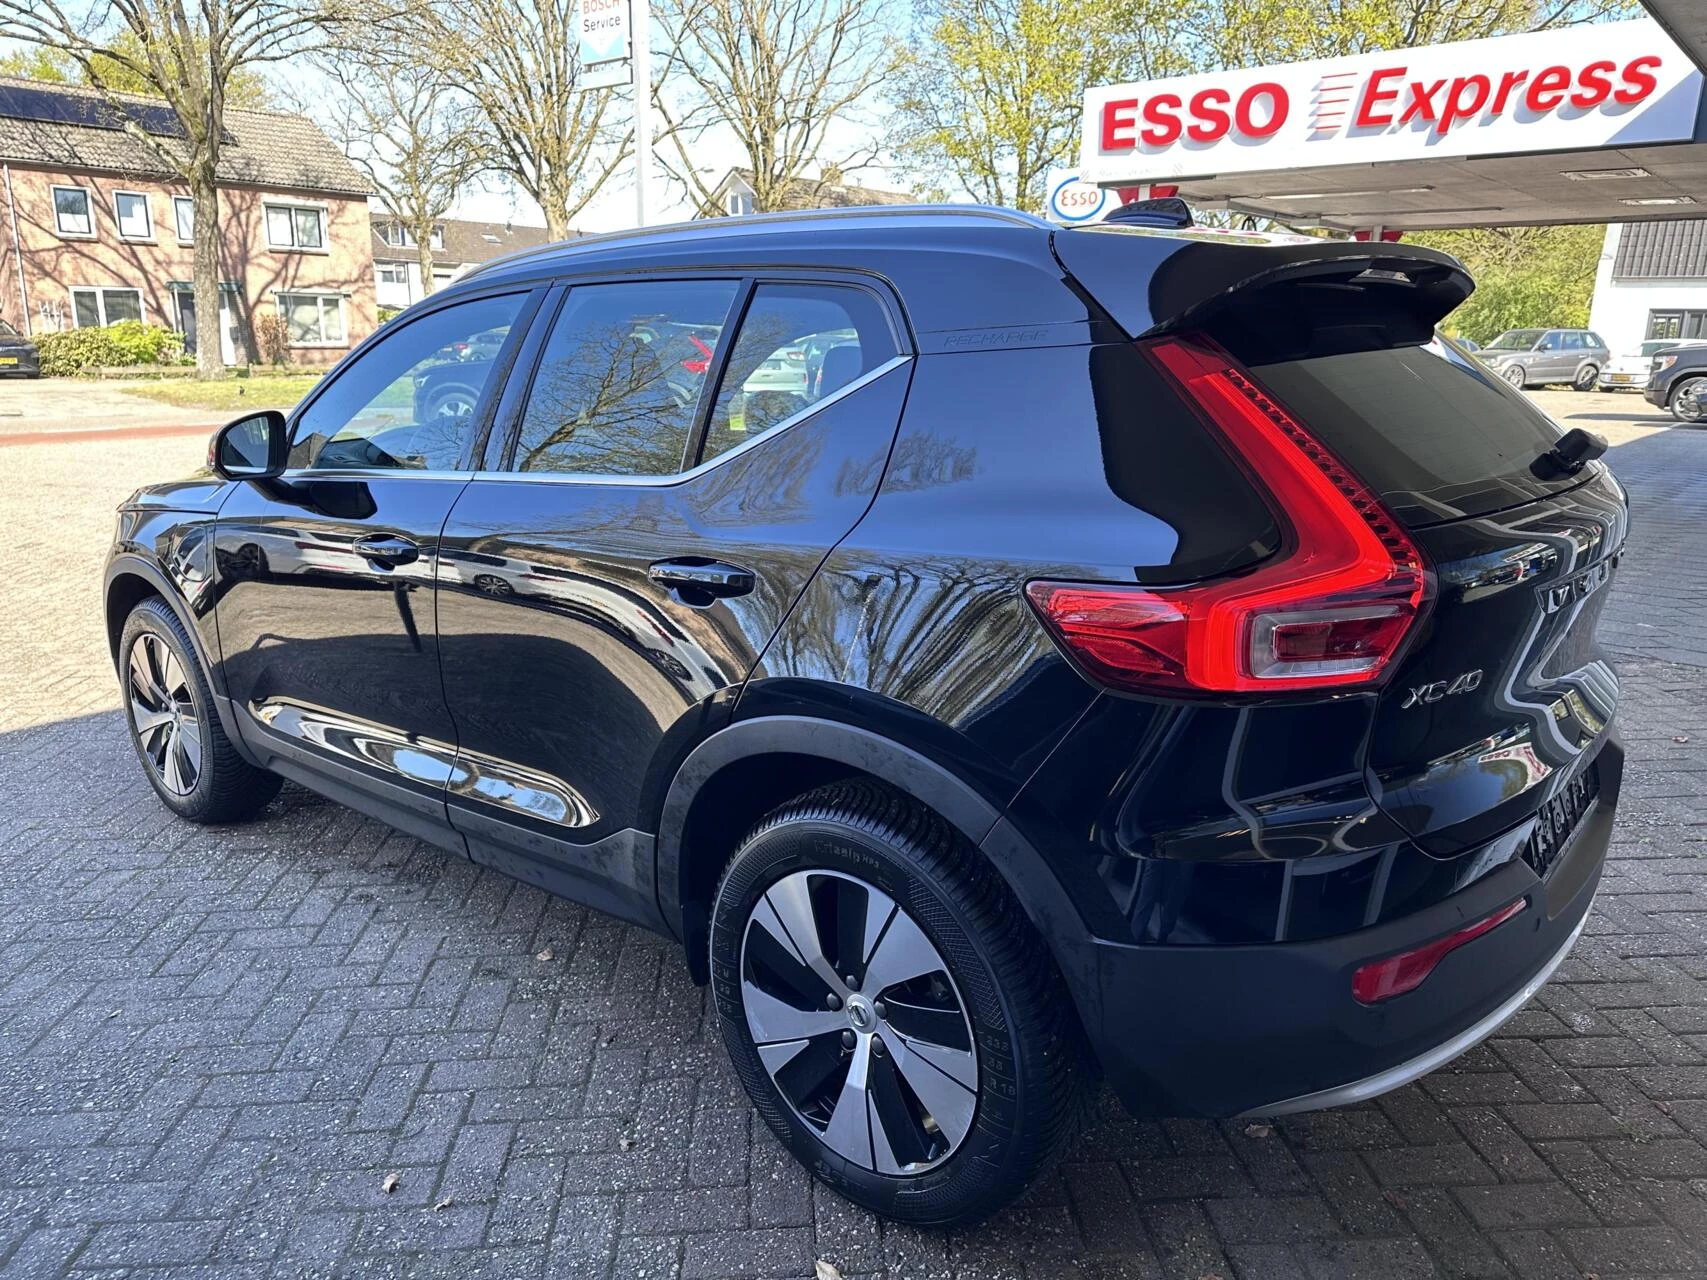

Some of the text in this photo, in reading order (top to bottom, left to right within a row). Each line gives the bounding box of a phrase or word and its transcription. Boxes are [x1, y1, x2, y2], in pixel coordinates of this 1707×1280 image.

[583, 16, 621, 32] Service
[1102, 55, 1662, 150] ESSO Express
[1401, 669, 1483, 709] XC40
